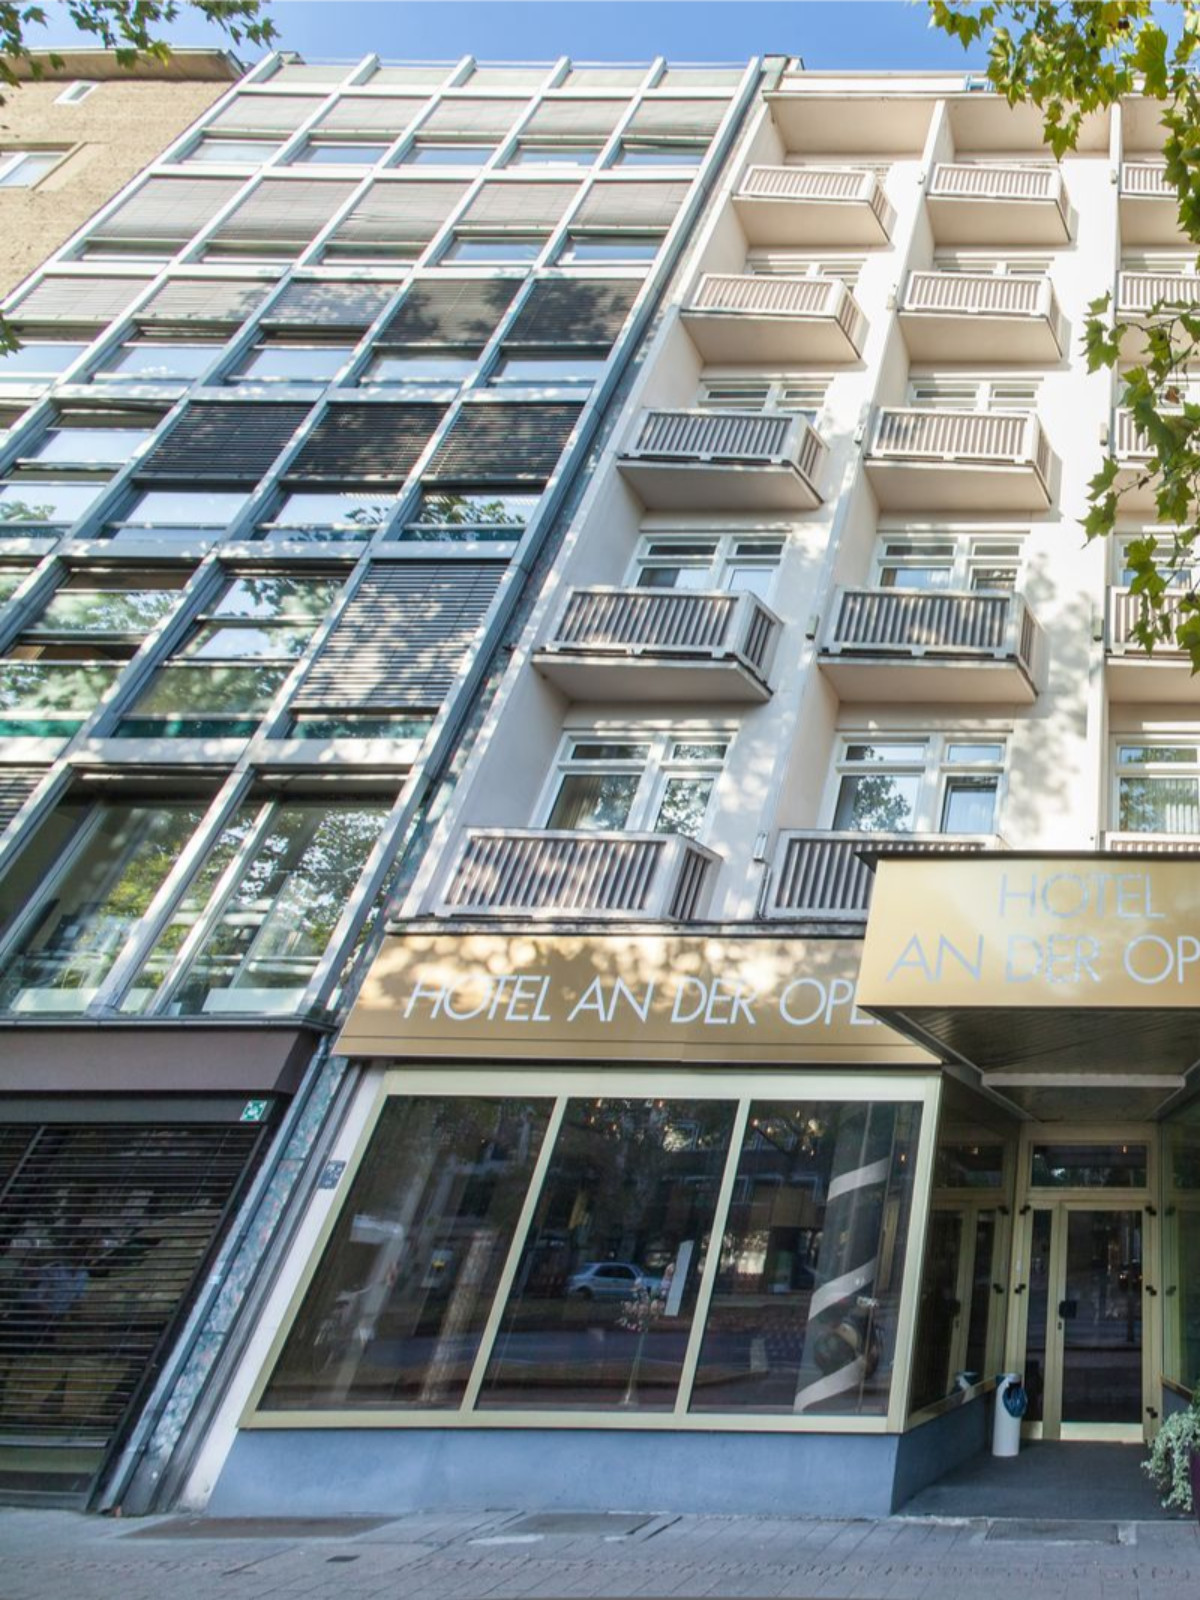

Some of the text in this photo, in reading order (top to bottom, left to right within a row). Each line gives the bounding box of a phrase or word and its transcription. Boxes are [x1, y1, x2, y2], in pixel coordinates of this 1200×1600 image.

[999, 872, 1166, 920] HOTEL
[885, 934, 985, 984] AN
[1005, 935, 1101, 985] DER
[402, 974, 882, 1026] HOTEL AN DER OP
